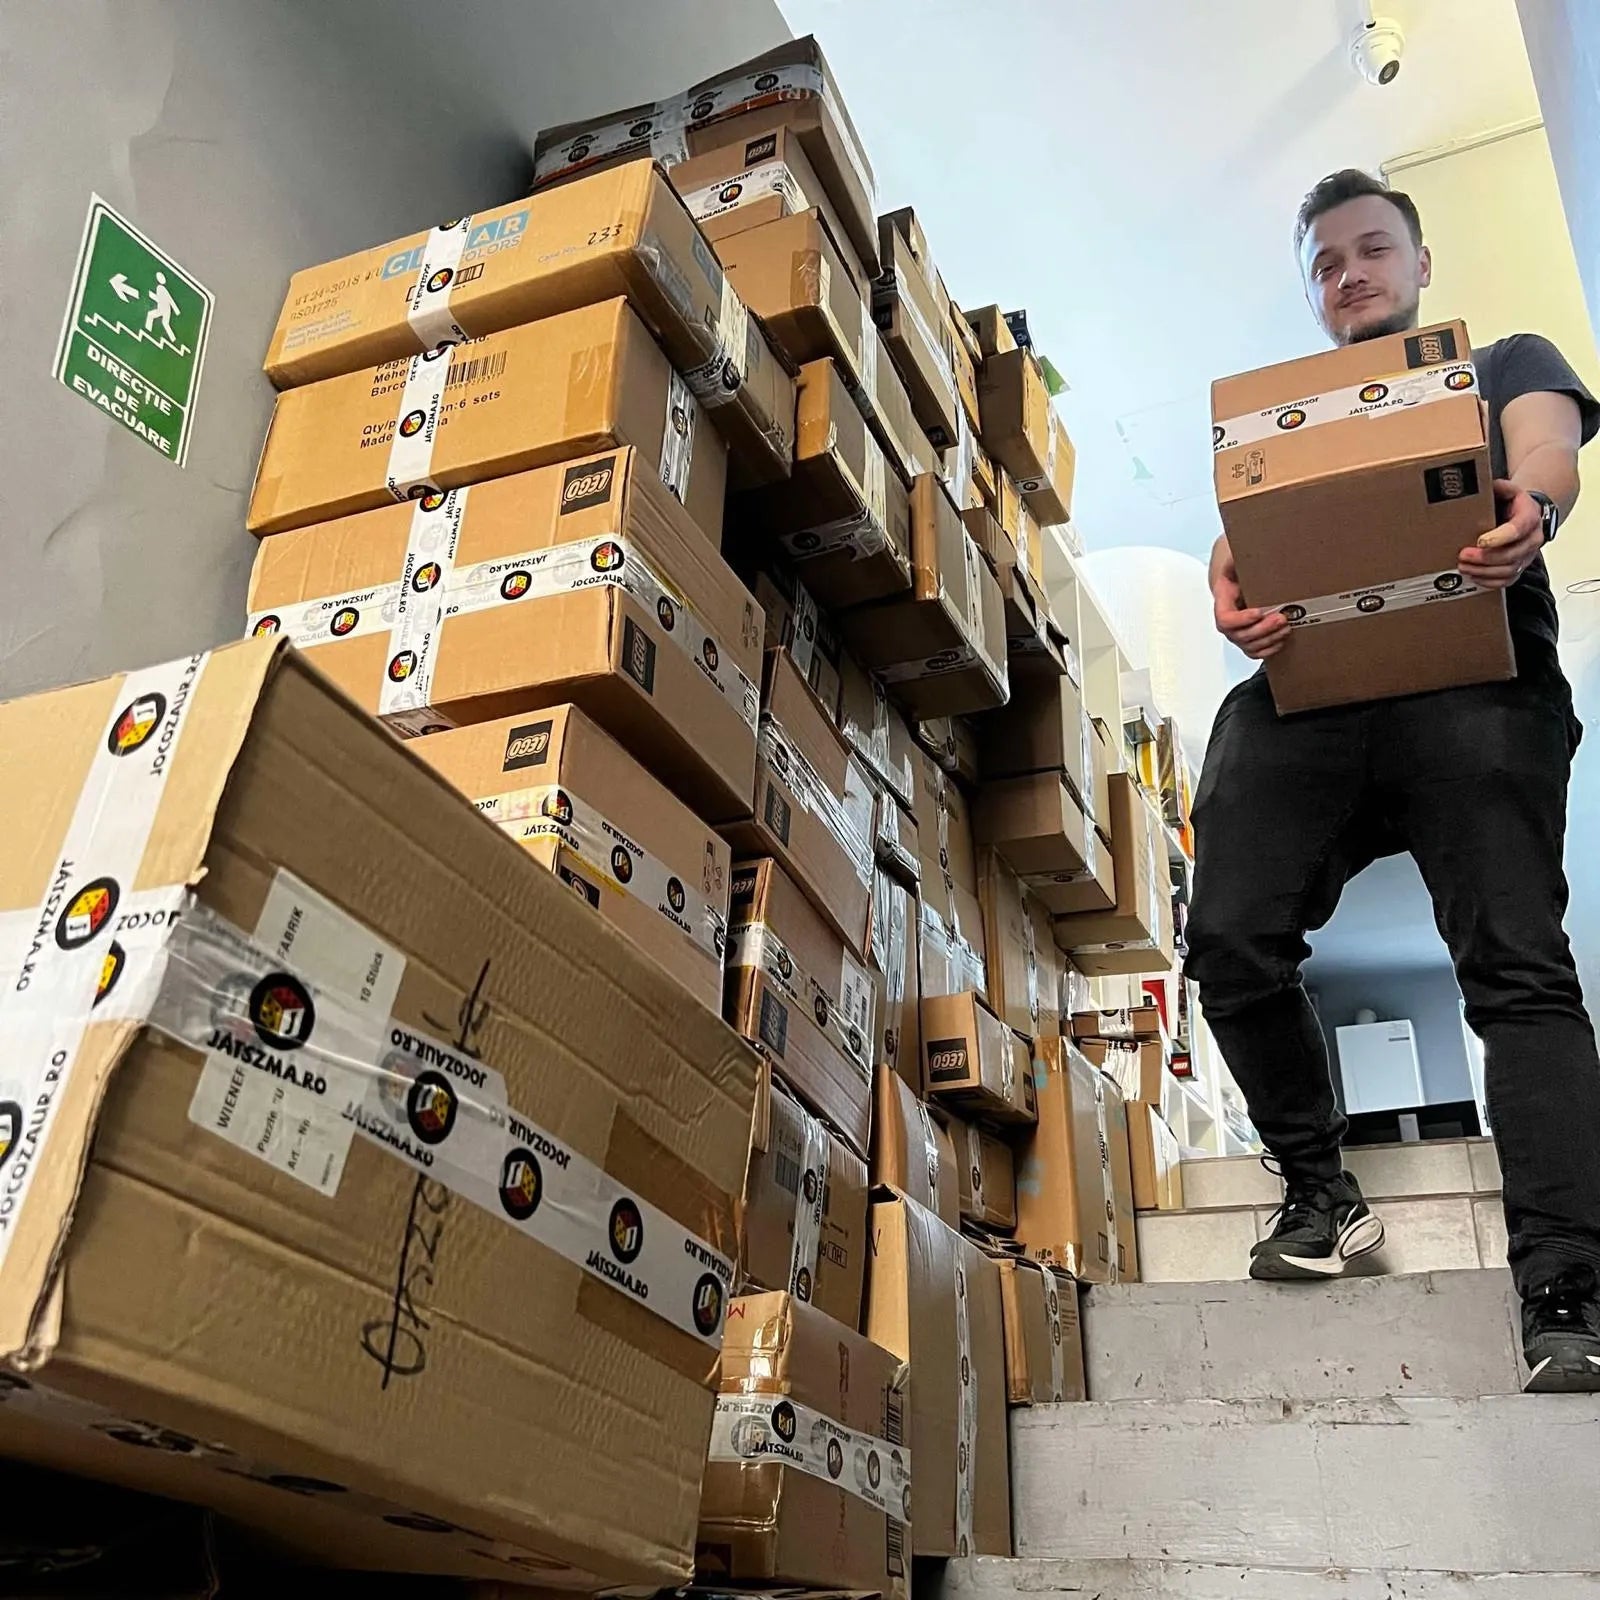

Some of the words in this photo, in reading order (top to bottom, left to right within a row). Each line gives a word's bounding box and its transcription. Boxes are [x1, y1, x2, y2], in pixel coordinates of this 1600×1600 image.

[748, 142, 774, 159] LEGO
[1419, 333, 1443, 363] LEGO
[87, 344, 173, 417] DIRECTIE
[114, 386, 139, 413] DE
[472, 390, 501, 405] sets
[72, 374, 171, 454] EVACUARE
[360, 432, 393, 449] Made
[562, 467, 612, 506] LEGO
[1440, 467, 1464, 497] LEGO
[505, 730, 550, 764] LEGO
[391, 1028, 488, 1089] JOCOZAUR.RO
[930, 1049, 967, 1070] LEGO
